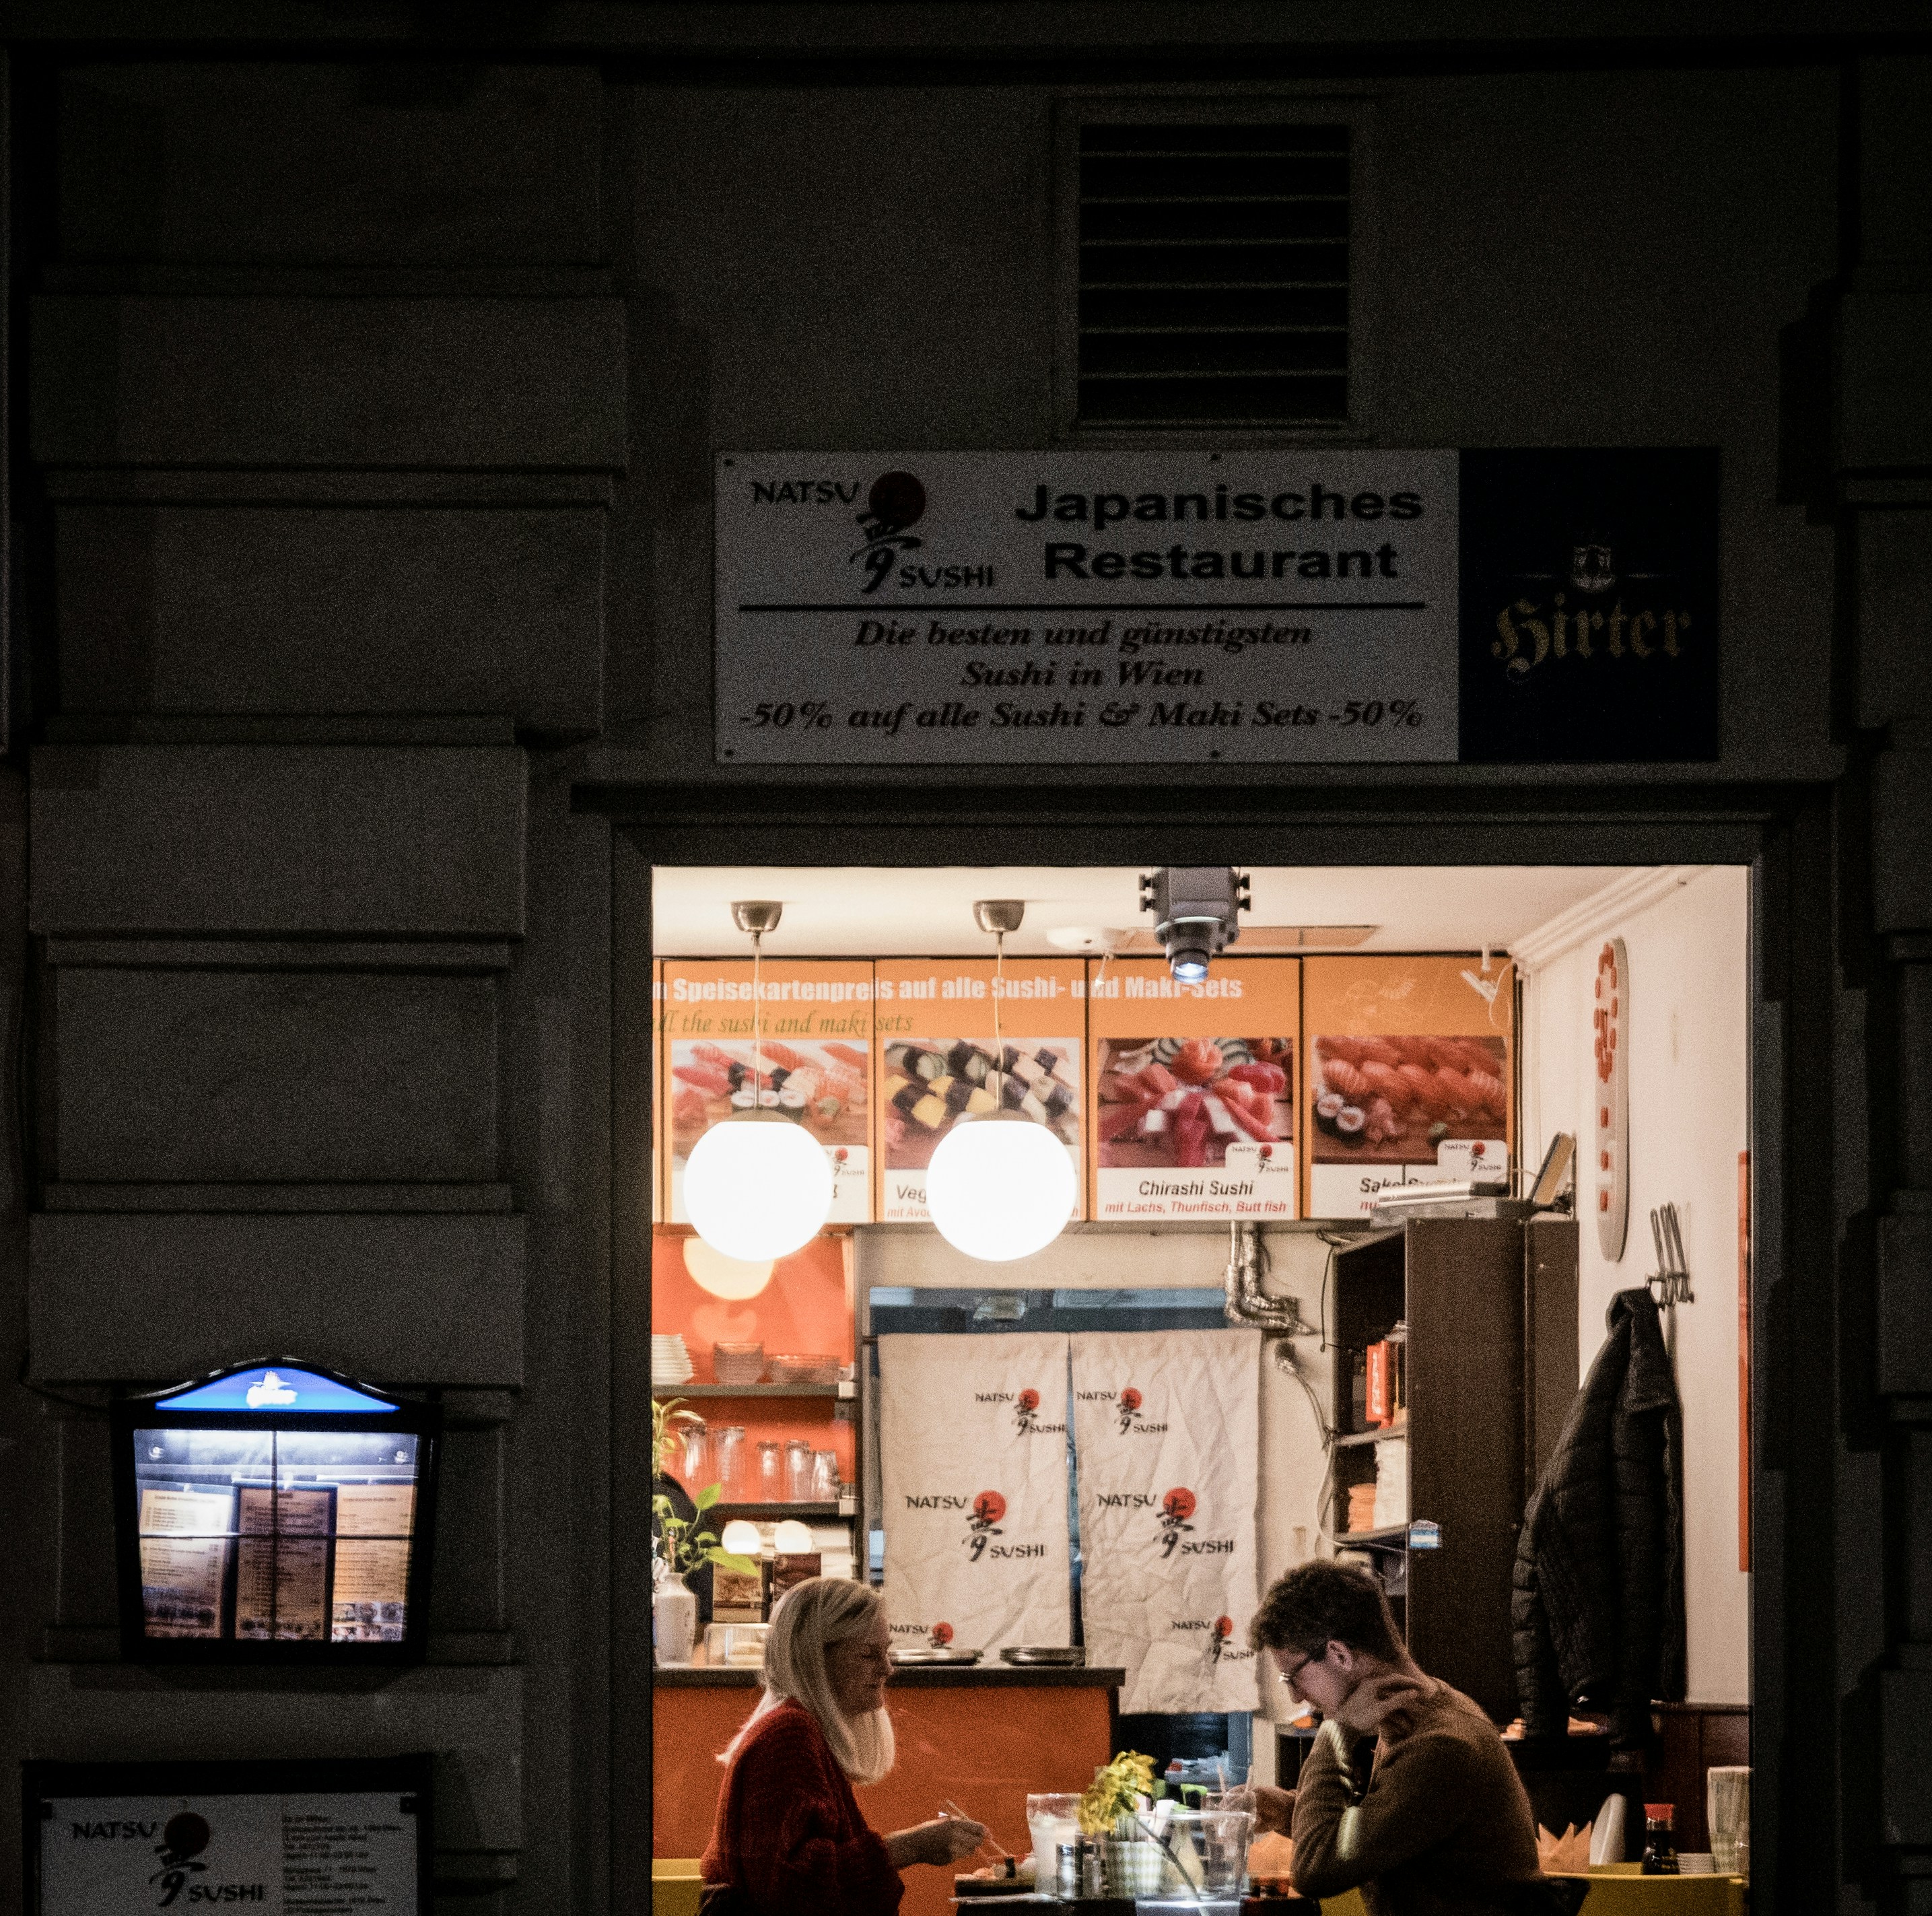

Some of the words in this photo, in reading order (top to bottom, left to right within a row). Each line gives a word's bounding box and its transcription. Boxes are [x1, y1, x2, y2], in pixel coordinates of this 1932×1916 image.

[751, 481, 860, 504] NATSU
[1016, 484, 1424, 530] Japanisches
[1045, 543, 1398, 579] Restaurant
[899, 565, 994, 589] SUSHI
[854, 620, 916, 646] Die
[928, 620, 1031, 646] besten
[1044, 621, 1111, 646] und
[1119, 621, 1312, 654] günstigsten
[961, 661, 1056, 687] Sushi
[1068, 661, 1103, 687] in
[1117, 661, 1206, 687] Wien
[741, 701, 833, 729] -50%
[848, 702, 912, 736] auf
[916, 702, 979, 728] alle
[990, 702, 1085, 728] Sushi
[1099, 702, 1140, 728] &
[1148, 701, 1243, 728] Maki
[1252, 702, 1320, 728] Sets
[1327, 699, 1422, 729] -50%
[673, 978, 893, 1004] Speisekartenpreis
[899, 977, 936, 1000] auf
[942, 976, 986, 1000] alle
[991, 976, 1066, 1000] Sushi-
[682, 1010, 712, 1033] the
[718, 1011, 769, 1033] sushi
[774, 1011, 813, 1033] and
[819, 1011, 868, 1037] maki
[875, 1015, 914, 1033] sets
[1138, 1179, 1204, 1195] Chirashi
[1210, 1179, 1254, 1195] Sushi
[1105, 1202, 1124, 1212] mit
[1127, 1202, 1165, 1214] Lachs,
[1171, 1200, 1231, 1214] Thunfisch,
[1237, 1200, 1261, 1212] Butt
[1264, 1200, 1286, 1212] fish
[975, 1393, 1014, 1402] NATSU
[1077, 1392, 1117, 1401] NATSU
[1029, 1424, 1066, 1433] SUSHI
[1133, 1423, 1169, 1433] SUSHI
[905, 1495, 968, 1509] NATSU
[1097, 1493, 1157, 1508] NATSU
[990, 1544, 1045, 1559] SUSHI
[1180, 1540, 1235, 1555] SUSHI
[889, 1623, 928, 1635] NATSU
[1172, 1620, 1211, 1629] NATSU
[73, 1820, 157, 1840] NATSU
[189, 1884, 265, 1903] SUSHI
